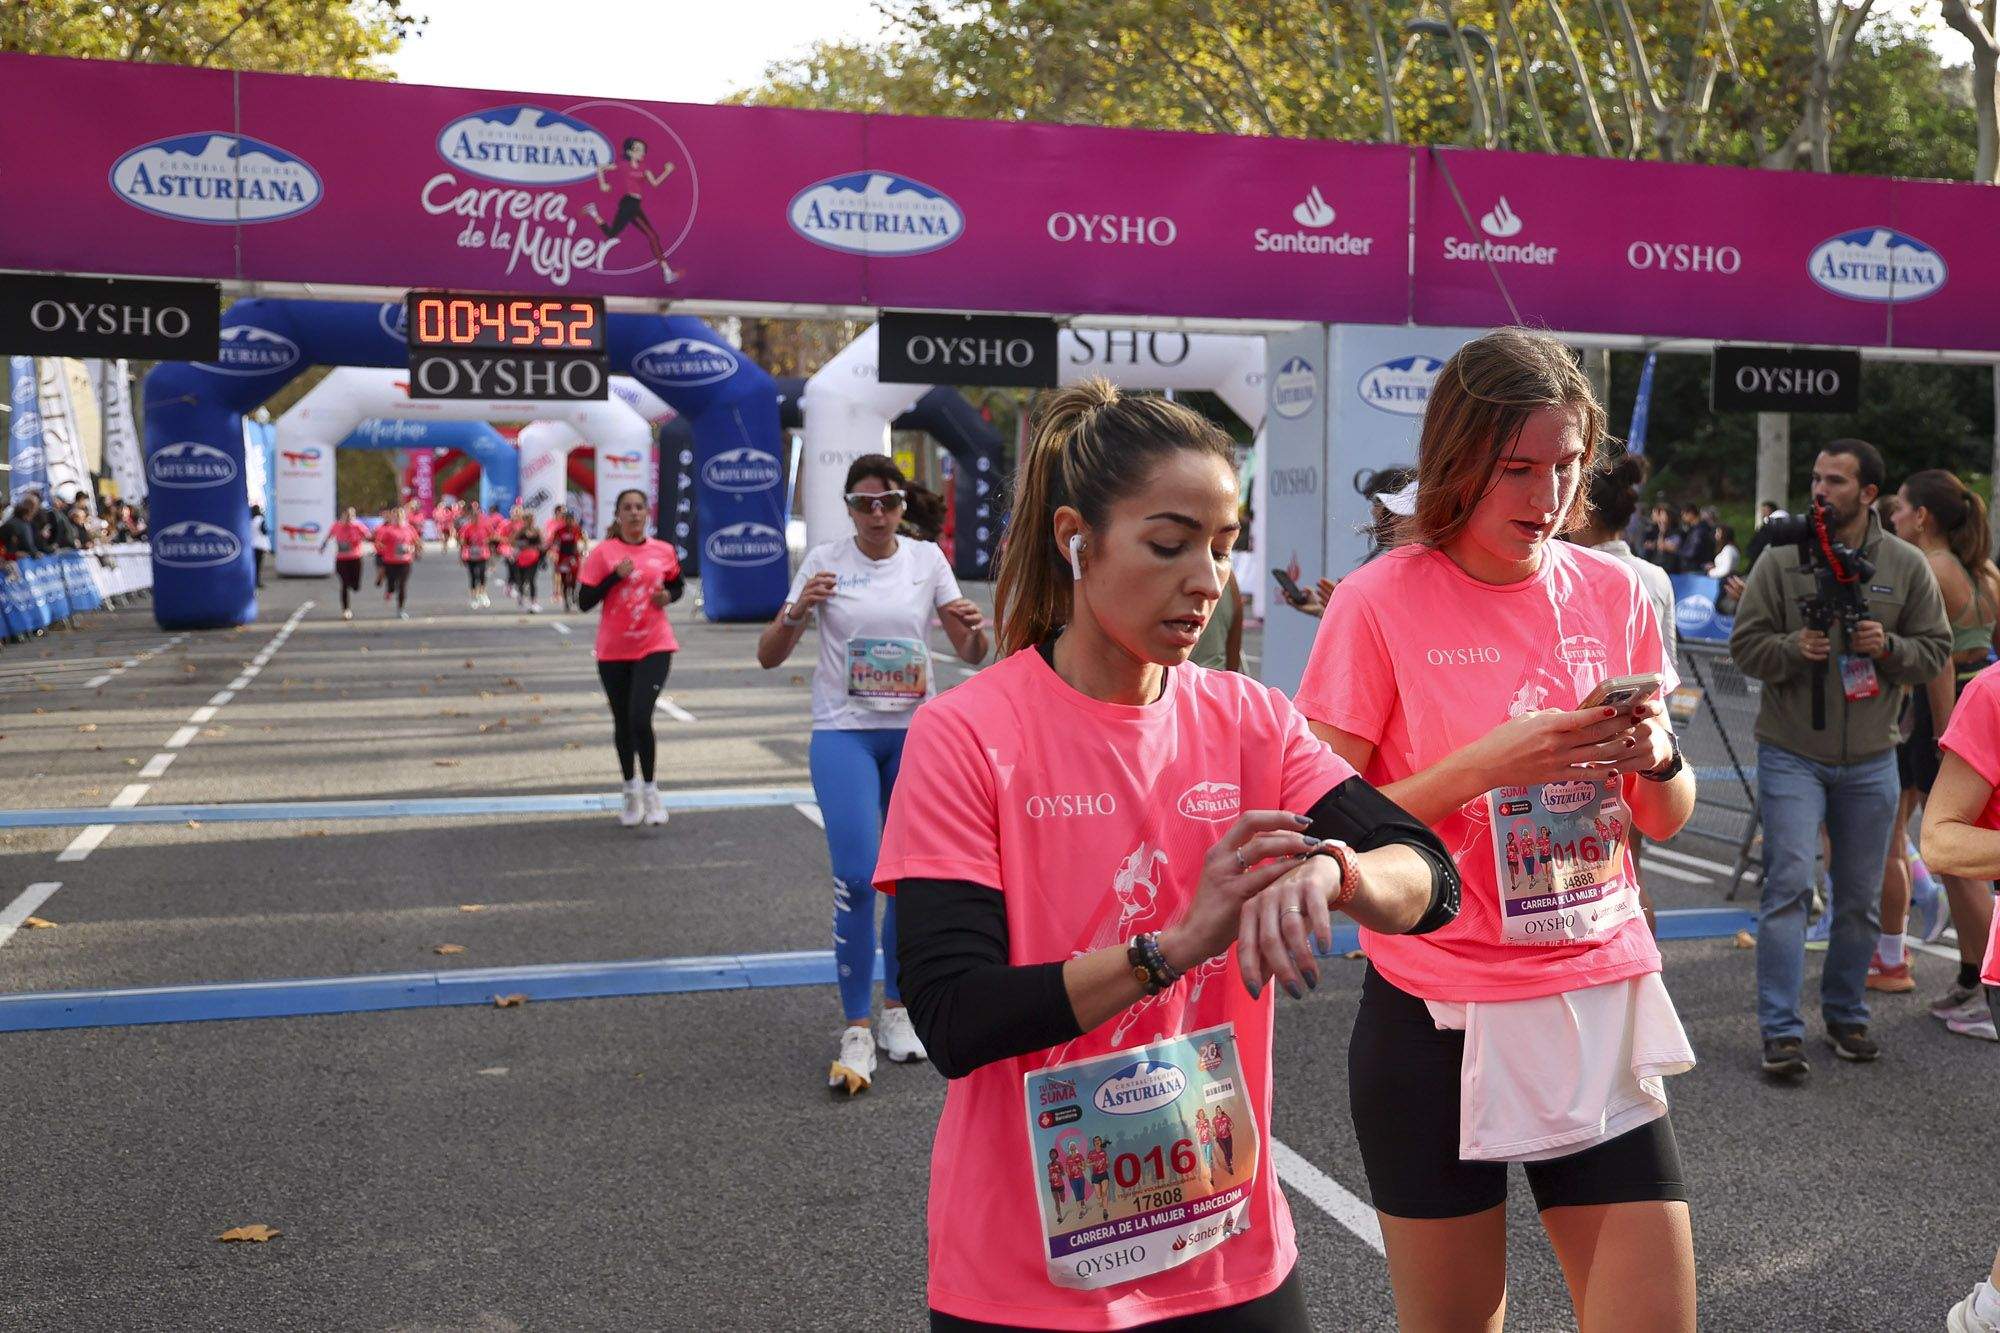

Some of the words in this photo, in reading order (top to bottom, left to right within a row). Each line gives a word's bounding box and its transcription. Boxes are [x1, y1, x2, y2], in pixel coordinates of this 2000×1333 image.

[453, 131, 599, 167] ASTURIANA
[129, 162, 305, 202] ASTURIANA
[421, 173, 569, 223] Carrera
[804, 199, 950, 235] ASTURIANA
[1046, 211, 1178, 246] OYSHO
[457, 218, 487, 248] de
[490, 220, 511, 249] la
[505, 218, 621, 286] Mujer
[1253, 228, 1374, 256] Santander
[1443, 236, 1558, 265] Santander
[1627, 241, 1742, 275] OYSHO
[1820, 252, 1936, 285] ASTURIANA
[30, 300, 191, 339] OYSHO
[418, 299, 595, 347] 00:45:52
[905, 335, 1035, 369] OYSHO
[1070, 328, 1191, 368] SHO
[417, 356, 602, 398] OYSHO
[1735, 365, 1840, 396] OYSHO
[1427, 646, 1502, 666] OYSHO
[1026, 792, 1117, 819] OYSHO
[1500, 786, 1529, 799] SUMA
[1544, 790, 1592, 806] ASTURIANA
[1553, 836, 1601, 870] 016
[1563, 872, 1595, 890] 34888
[1520, 900, 1558, 910] CARRERA
[1576, 889, 1598, 901] MUJER
[1525, 914, 1575, 935] OYSHO
[1040, 1086, 1077, 1106] SUMA
[1101, 1077, 1183, 1109] ASTURIANA
[1113, 1138, 1197, 1188] 016
[1132, 1187, 1183, 1213] 17808
[1069, 1226, 1117, 1248] CARRERA
[1118, 1220, 1133, 1234] DE
[1135, 1218, 1149, 1231] LA
[1151, 1207, 1186, 1227] MUJER
[1193, 1188, 1243, 1215] BARCELONA
[1076, 1245, 1147, 1280] OYSHO
